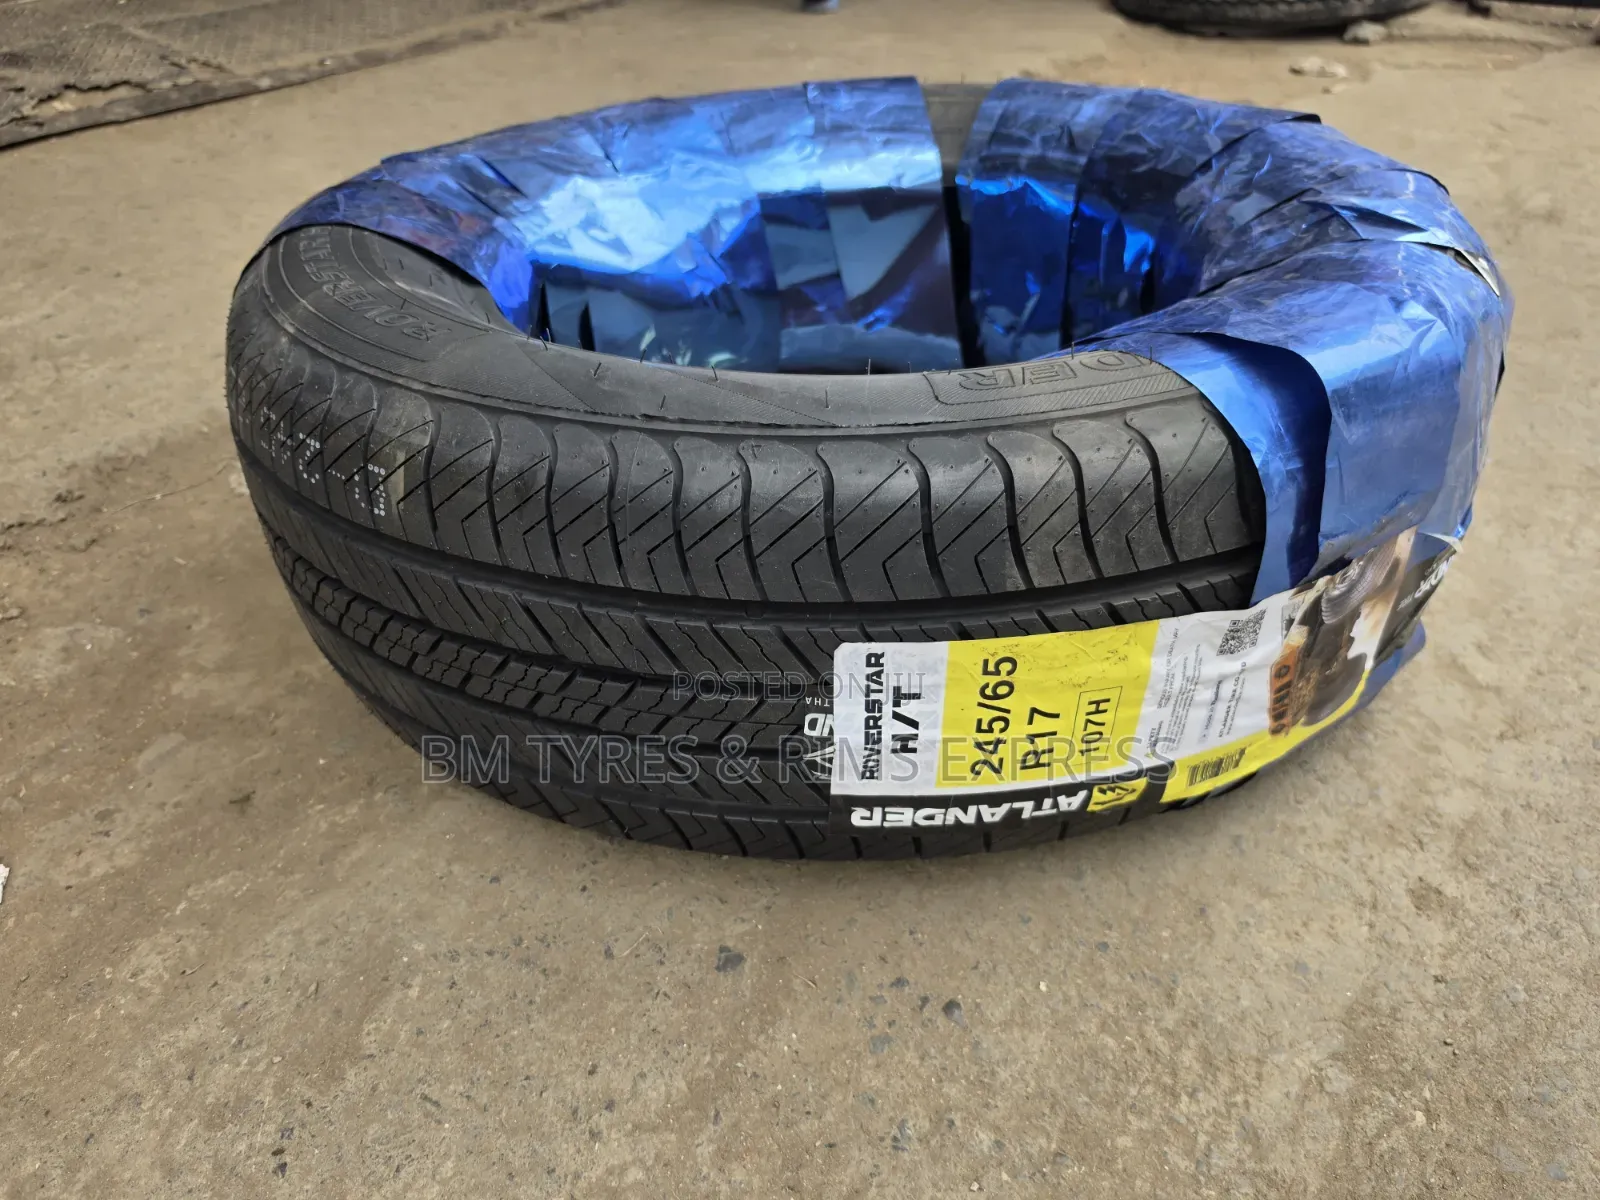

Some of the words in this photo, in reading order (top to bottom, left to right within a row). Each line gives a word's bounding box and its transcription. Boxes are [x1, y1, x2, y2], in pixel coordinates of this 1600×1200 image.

[861, 651, 885, 780] ROVERSTAR
[891, 686, 922, 754] H/T
[970, 656, 1018, 778] 245/65
[1019, 706, 1061, 771] R17
[1077, 697, 1112, 757] 107H
[850, 789, 1091, 828] ATLANDER
